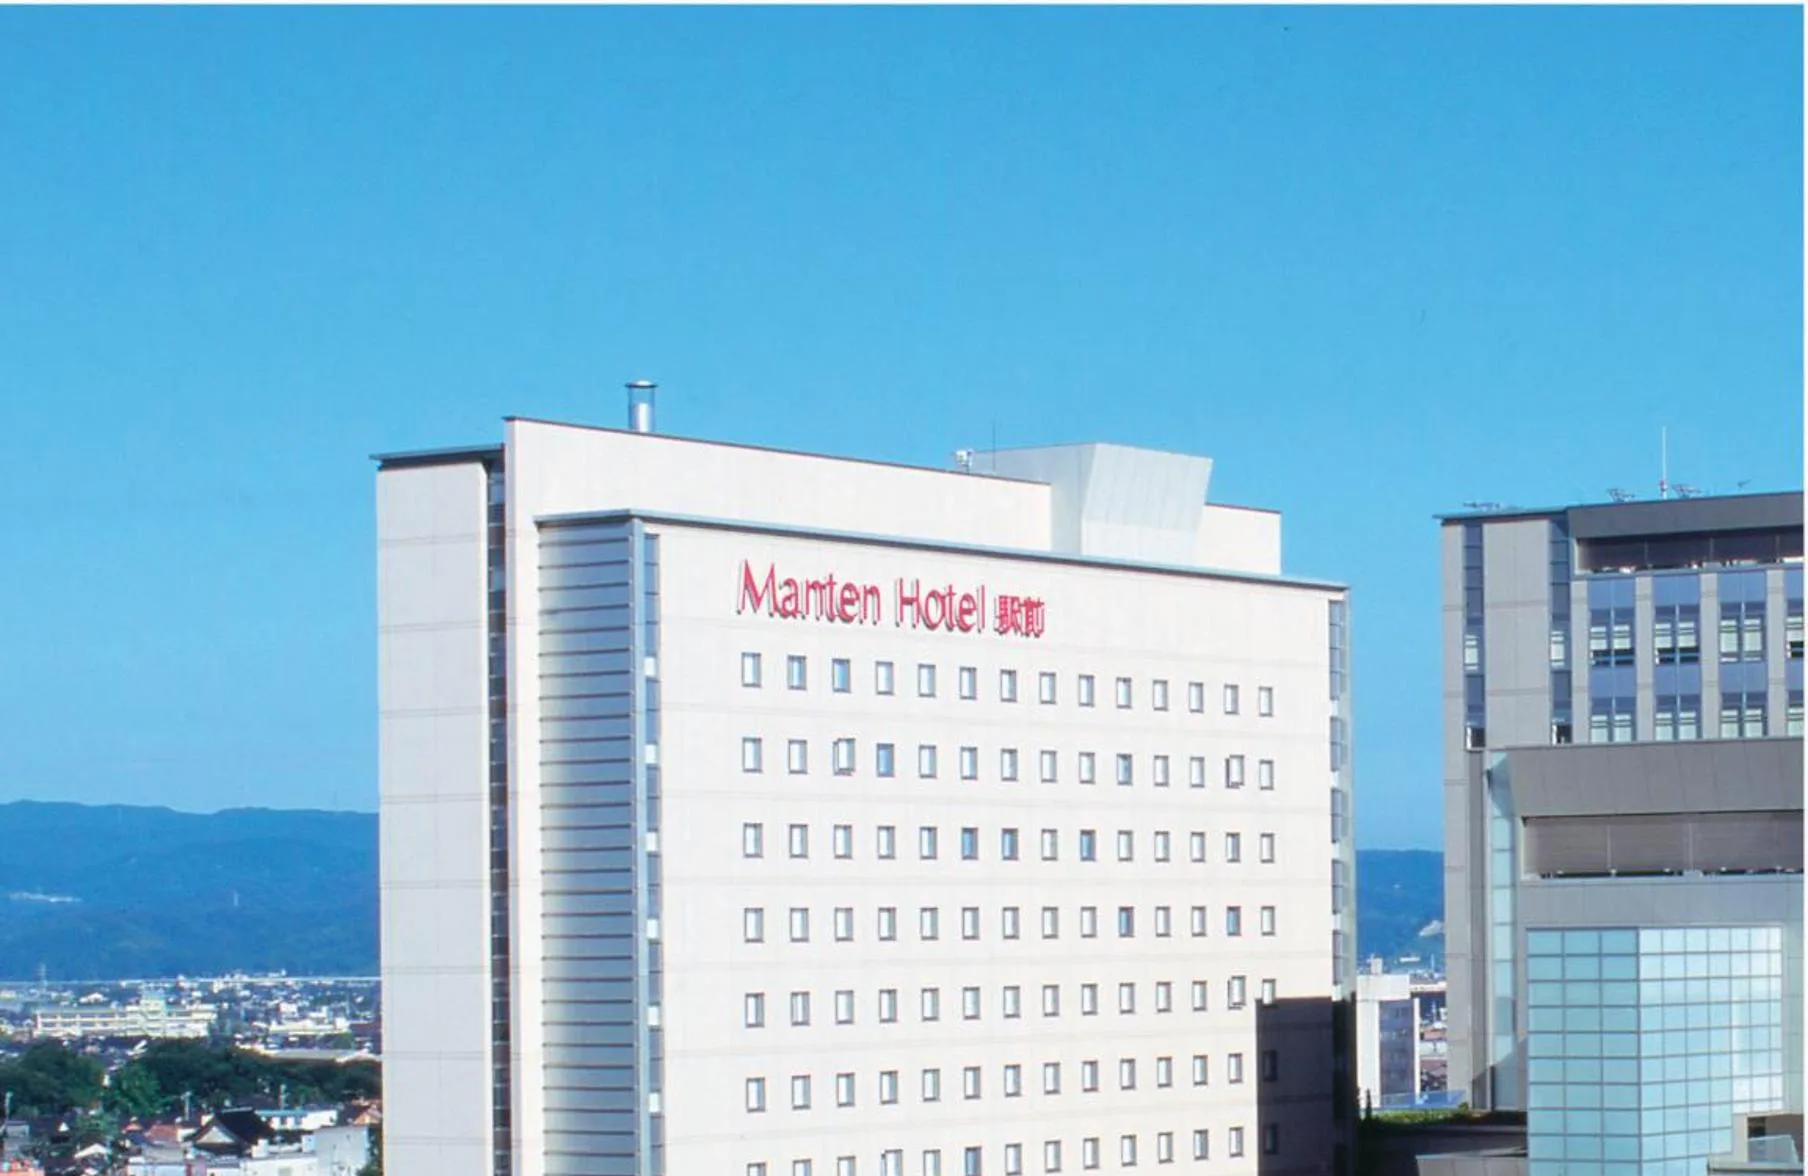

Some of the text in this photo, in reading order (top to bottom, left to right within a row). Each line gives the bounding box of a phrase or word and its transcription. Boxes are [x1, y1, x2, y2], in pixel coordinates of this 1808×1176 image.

[737, 559, 1045, 638] Manten Hotel 駅前
